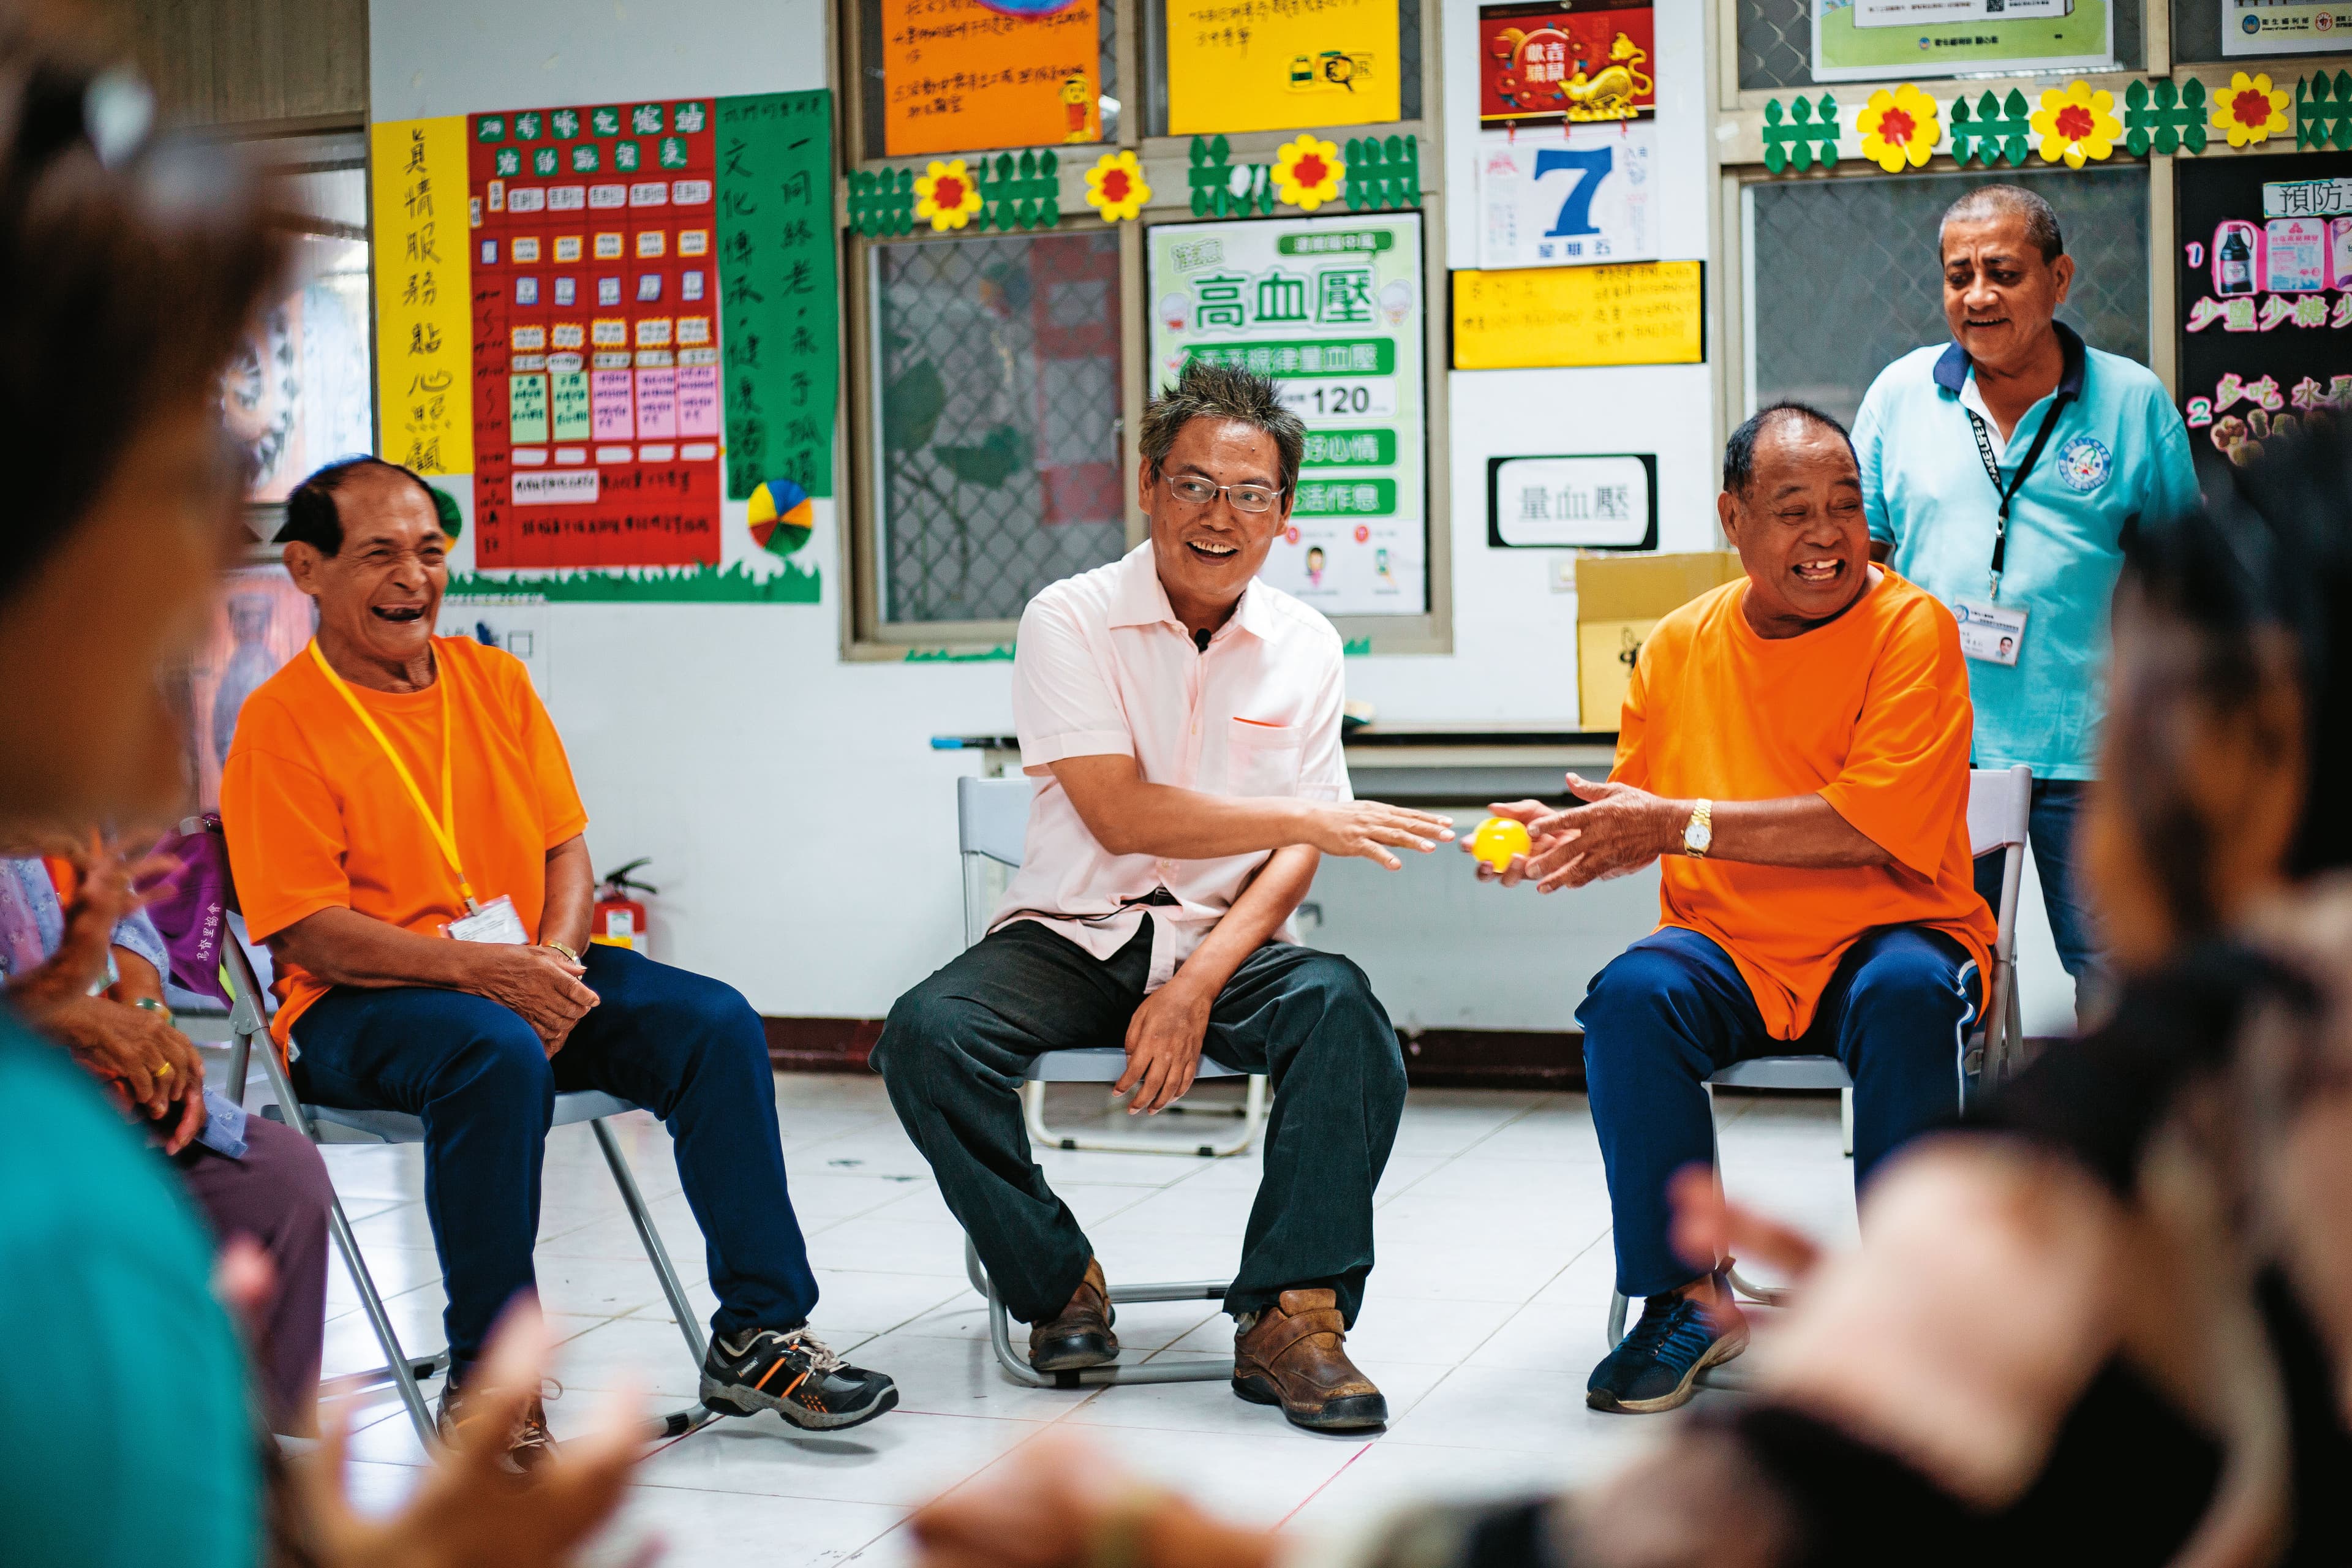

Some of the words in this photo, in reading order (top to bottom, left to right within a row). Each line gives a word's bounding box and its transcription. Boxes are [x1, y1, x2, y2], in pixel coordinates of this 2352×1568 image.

[1534, 146, 1612, 237] 7
[1194, 270, 1371, 329] 高血壓
[1312, 386, 1369, 413] 120
[2189, 399, 2211, 426] 2
[1519, 484, 1629, 521] 量血壓
